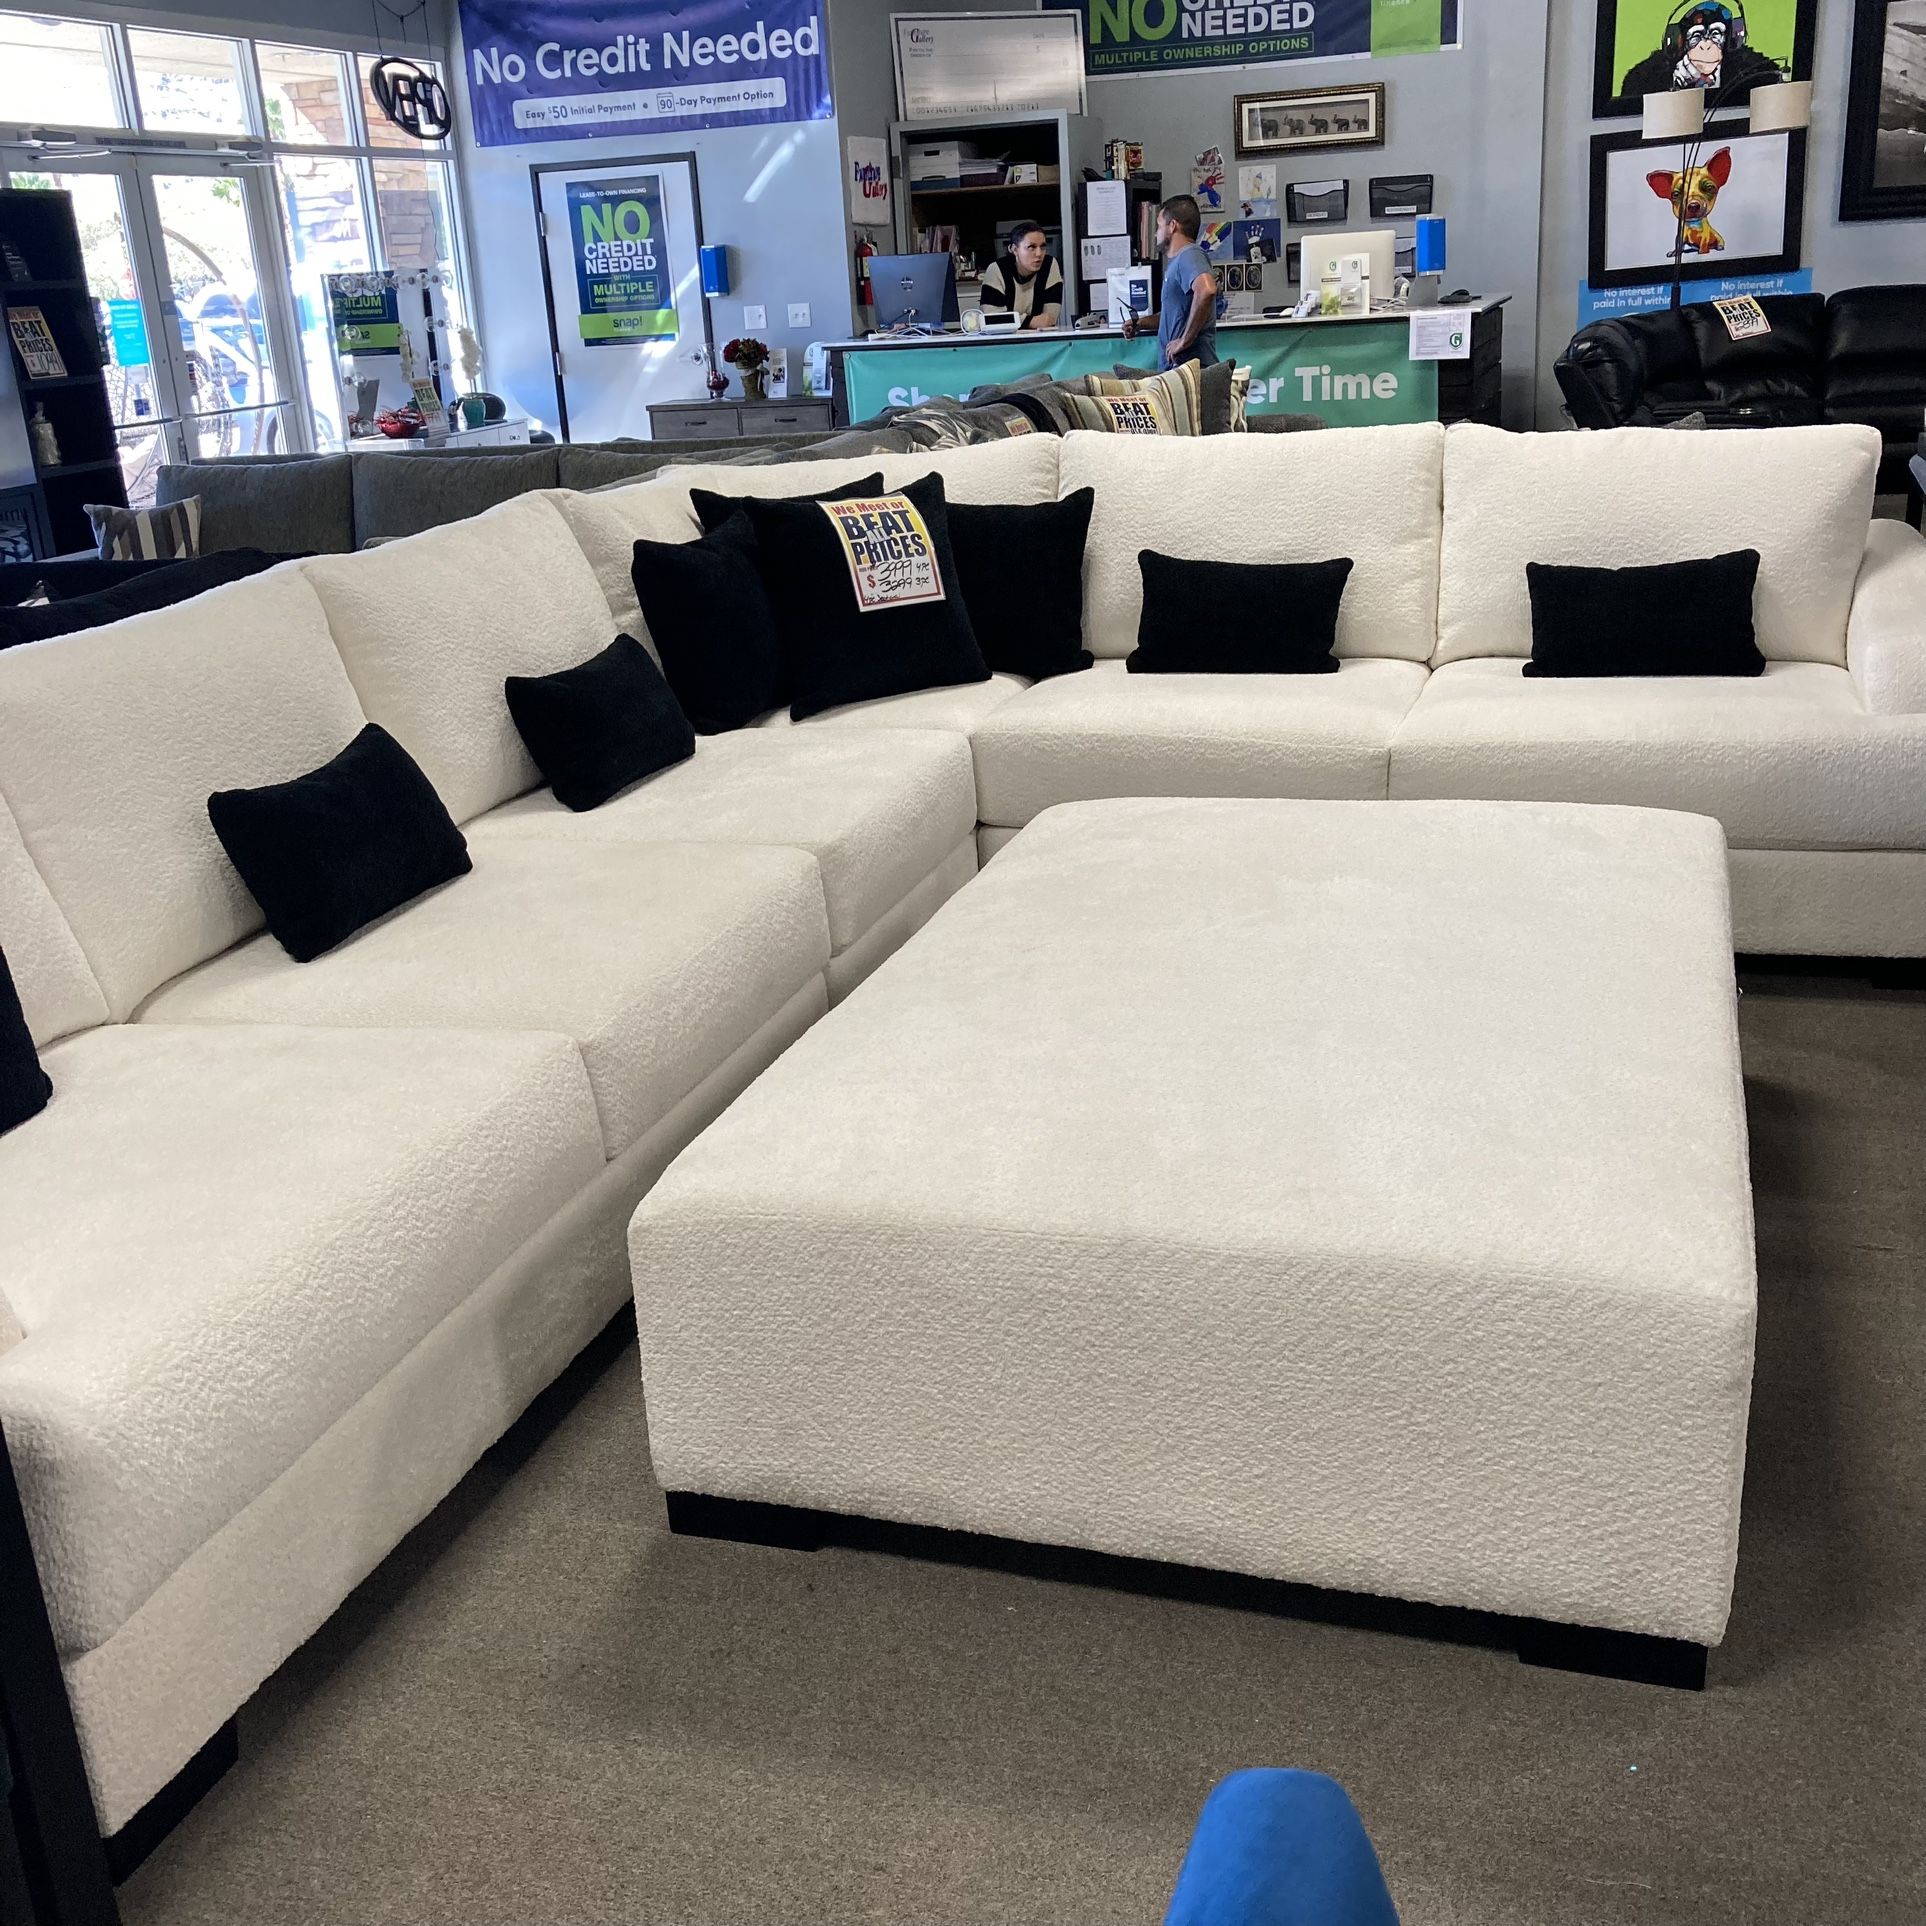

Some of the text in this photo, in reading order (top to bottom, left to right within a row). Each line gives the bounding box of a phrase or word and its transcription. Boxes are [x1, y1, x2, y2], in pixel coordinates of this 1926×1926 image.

[1089, 0, 1178, 44] NO
[1181, 2, 1315, 39] NEEDED
[472, 15, 820, 85] No Credit Needed
[1094, 37, 1310, 65] MULTIPLE OWNERSHIP OPTIONS
[525, 110, 546, 120] Easy
[548, 105, 568, 119] $50
[570, 105, 596, 116] Initial
[597, 102, 636, 115] Payment
[700, 93, 741, 105] Payment
[743, 90, 774, 102] Option
[580, 200, 651, 244] NO
[584, 238, 654, 259] CREDIT
[585, 255, 657, 274] NEEDED
[593, 281, 654, 296] MULTIPLE
[1604, 285, 1664, 298] No interest if
[1721, 278, 1784, 291] No interest if
[1593, 299, 1615, 310] paid
[1617, 299, 1626, 307] in
[1628, 297, 1642, 306] full
[10, 320, 46, 339] BEAT
[613, 316, 642, 329] snap!
[1294, 364, 1398, 401] Time
[1110, 402, 1151, 415] BEAT
[1116, 416, 1157, 429] PRICES
[832, 500, 905, 516] We Meet or
[838, 510, 916, 540] BEAT
[865, 527, 891, 545] ALL
[850, 533, 927, 566] PRICES
[866, 574, 877, 589] $
